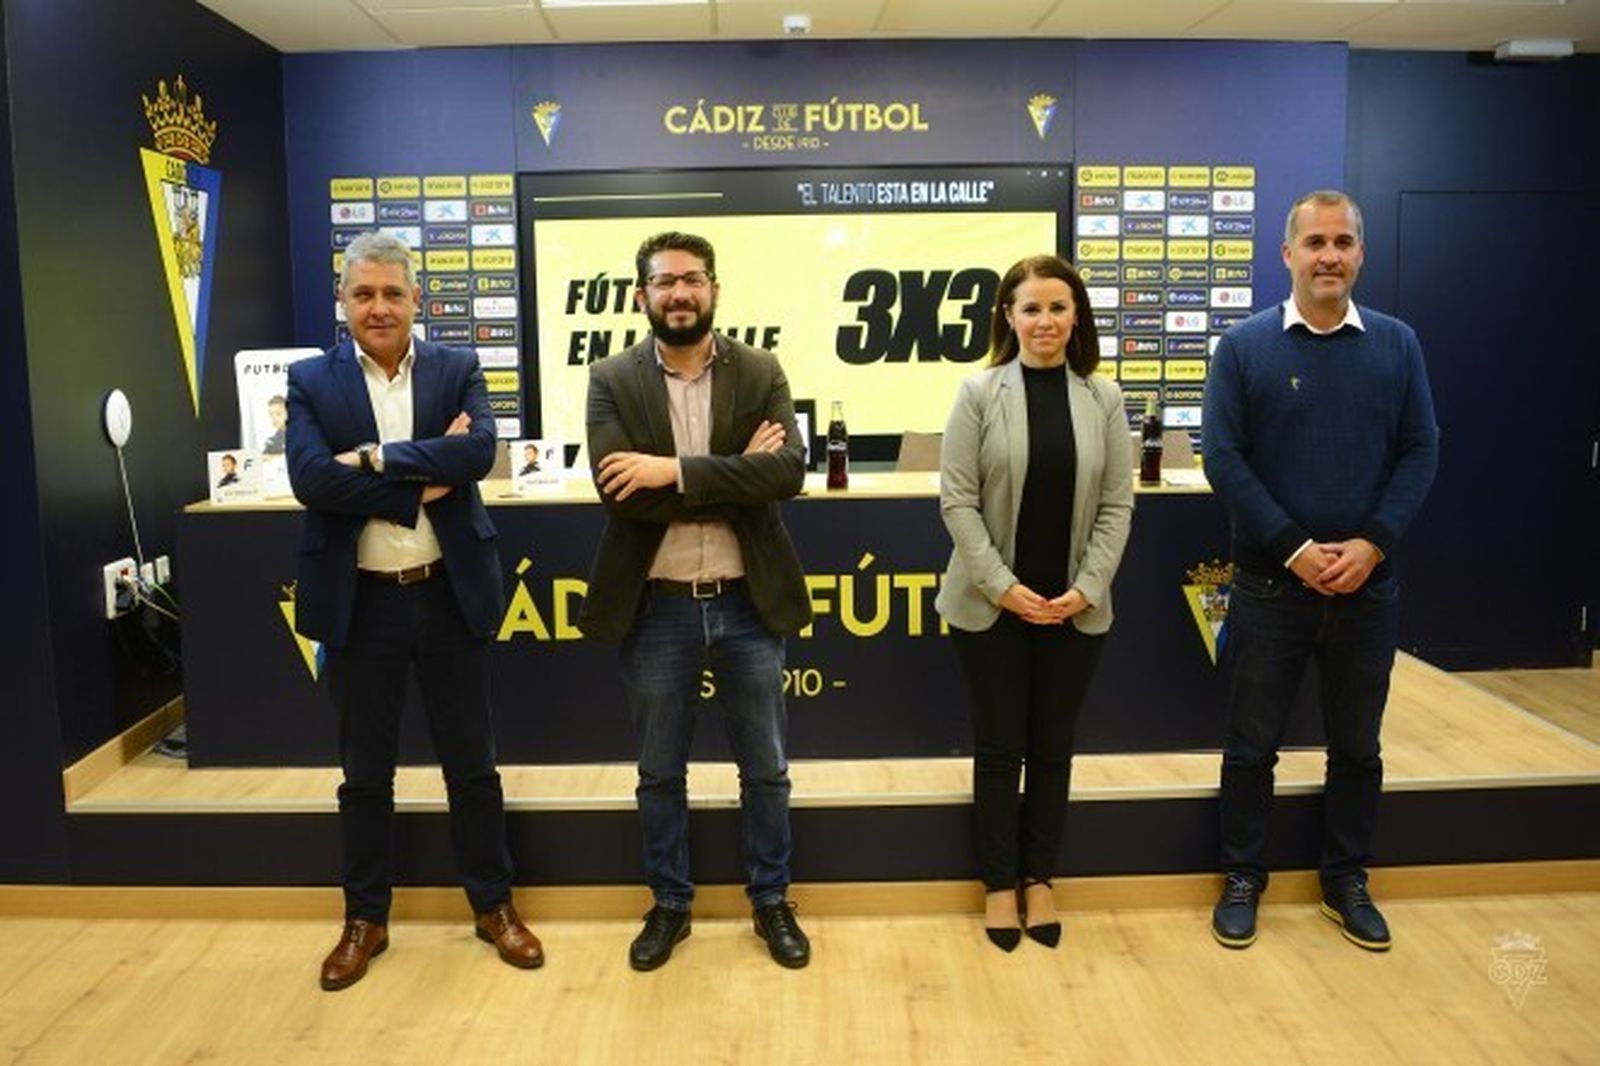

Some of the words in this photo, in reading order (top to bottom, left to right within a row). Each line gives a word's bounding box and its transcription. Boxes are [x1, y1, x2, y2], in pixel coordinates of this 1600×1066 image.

[664, 99, 765, 134] CÁDIZ
[804, 97, 929, 132] FÚTBOL
[877, 182, 910, 204] ESTA
[911, 182, 928, 204] EN
[930, 182, 947, 204] LA
[565, 272, 641, 315] FÚT
[836, 268, 1001, 365] 3X3
[567, 331, 612, 365] EN
[800, 553, 950, 638] FÚT
